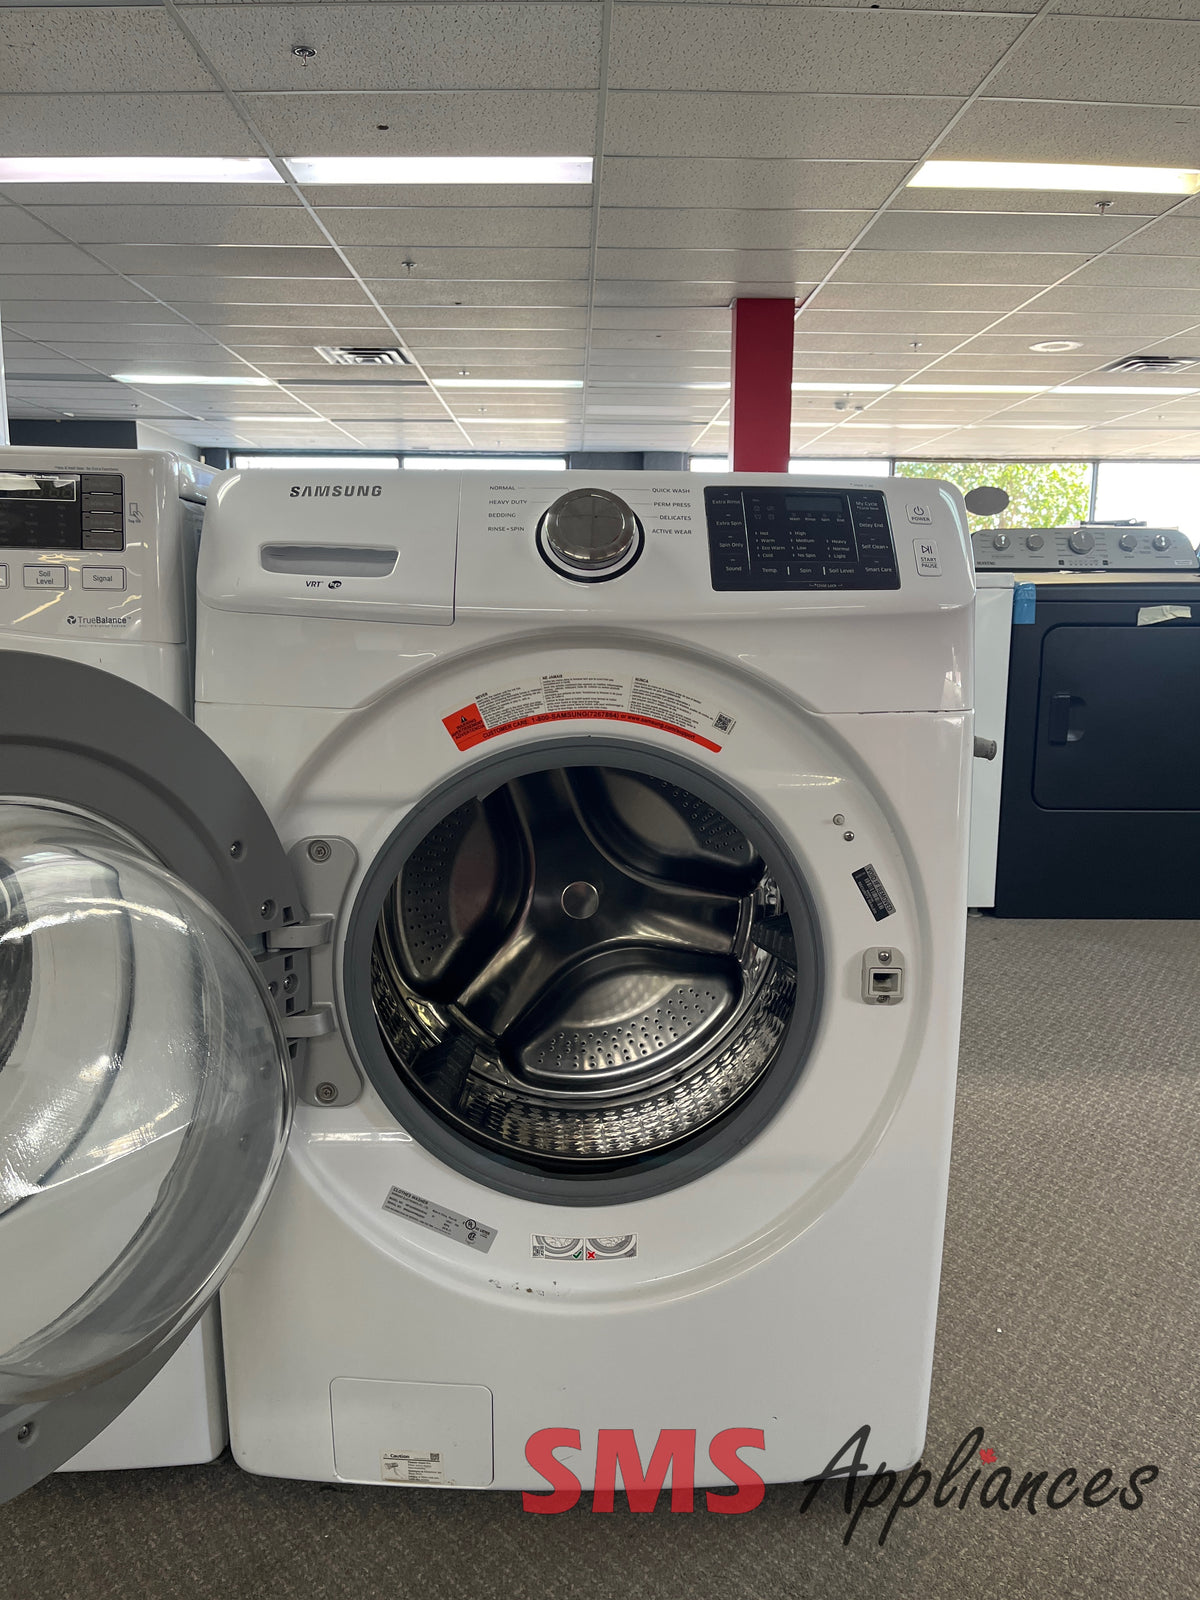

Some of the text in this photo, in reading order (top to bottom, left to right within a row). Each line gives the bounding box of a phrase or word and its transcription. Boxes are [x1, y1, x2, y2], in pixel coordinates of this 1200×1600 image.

[289, 485, 382, 497] SAMSUNG
[92, 575, 113, 583] Signal
[475, 692, 488, 700] NEVER
[456, 718, 477, 729] WARNING
[482, 724, 512, 738] CUSTOMER
[512, 720, 528, 728] CARE
[866, 867, 877, 880] VOID
[877, 887, 893, 911] REMOVED
